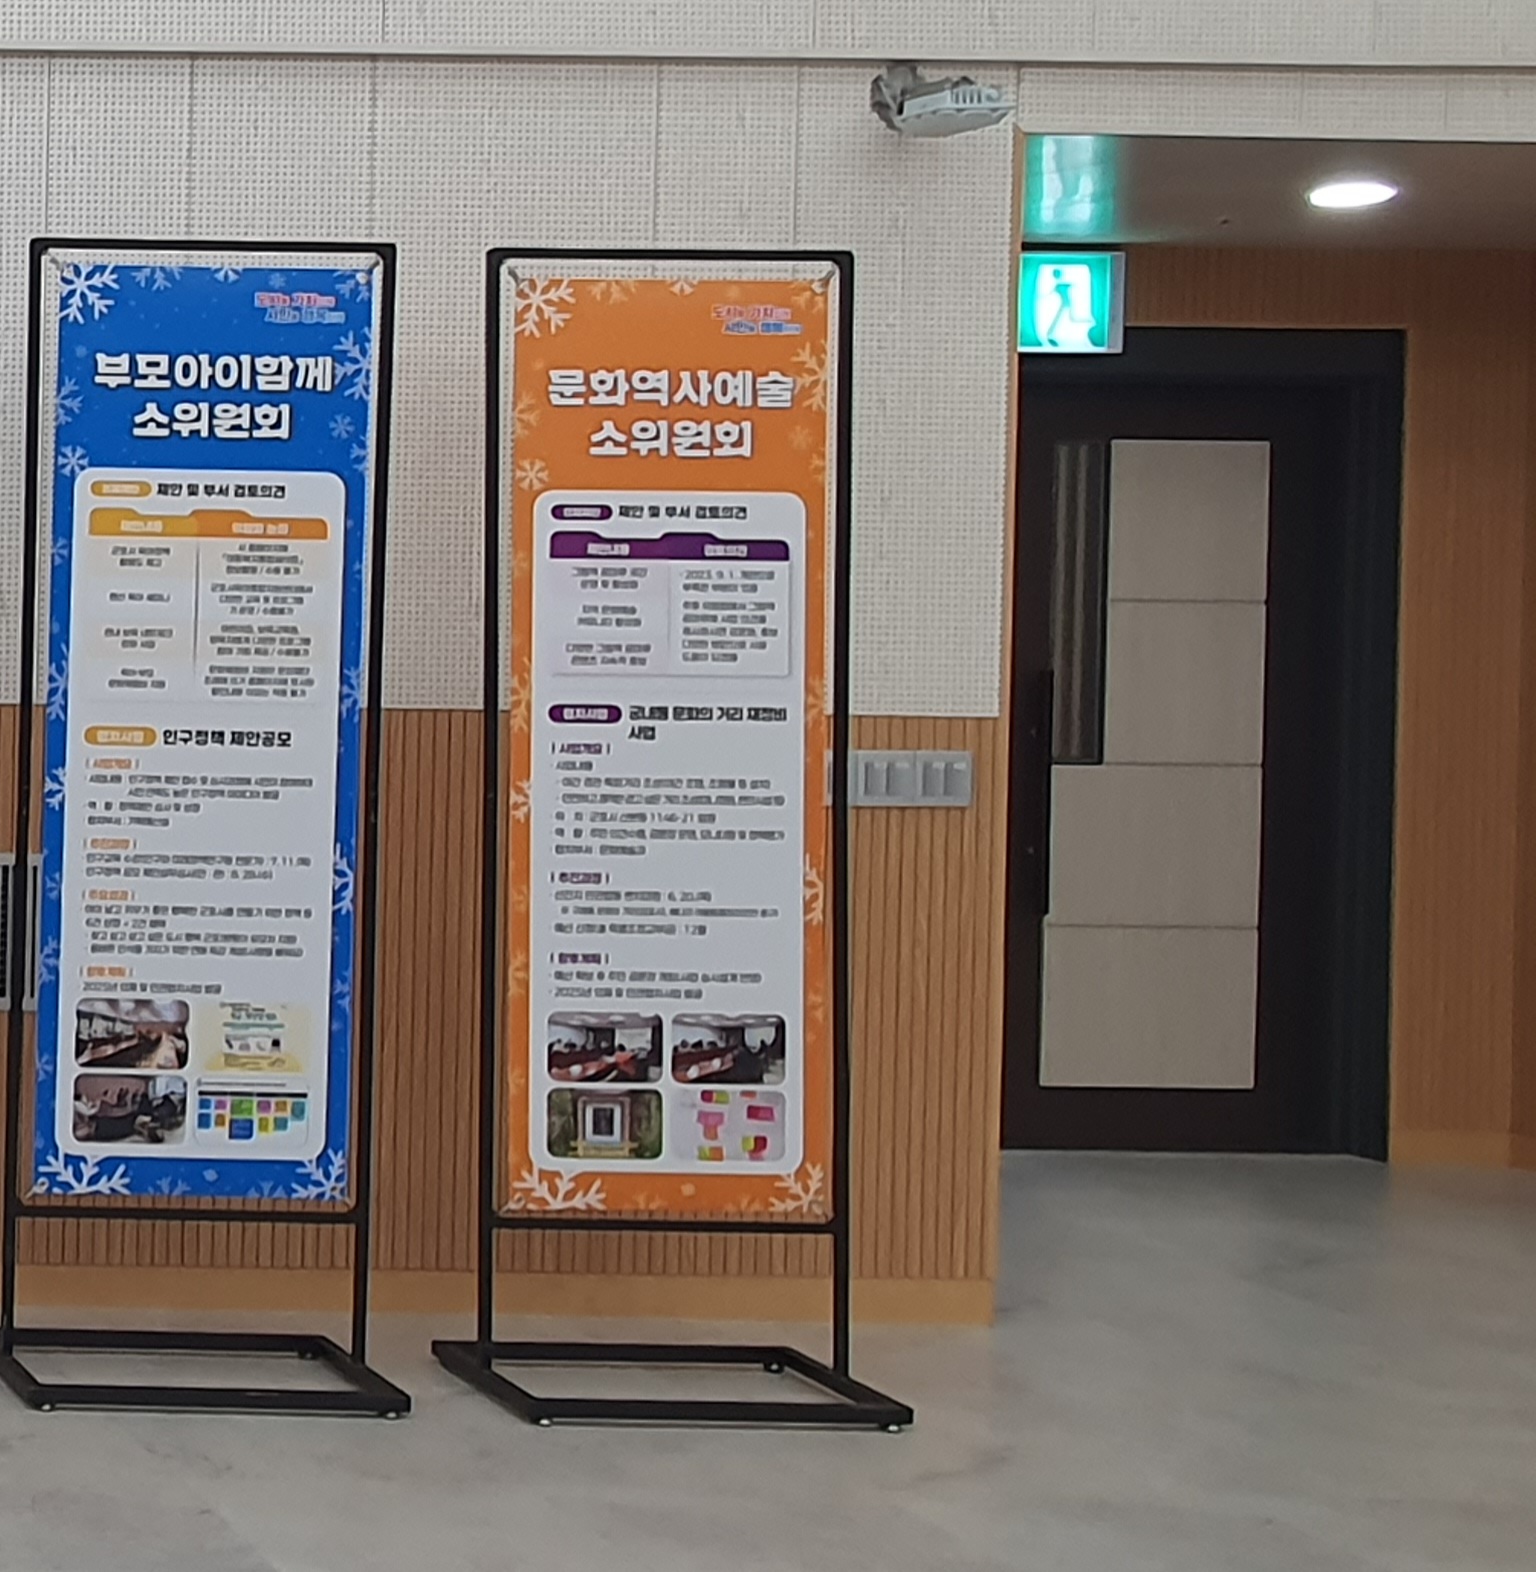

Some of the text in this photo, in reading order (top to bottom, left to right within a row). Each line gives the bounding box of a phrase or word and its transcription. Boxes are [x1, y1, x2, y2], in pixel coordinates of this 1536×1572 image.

[94, 352, 333, 392] 부모아이함께
[547, 368, 795, 408] 문화역사예술
[132, 403, 292, 440] 소위원회
[589, 420, 752, 458] 소위원회
[162, 729, 292, 748] 인구정책 제안공모
